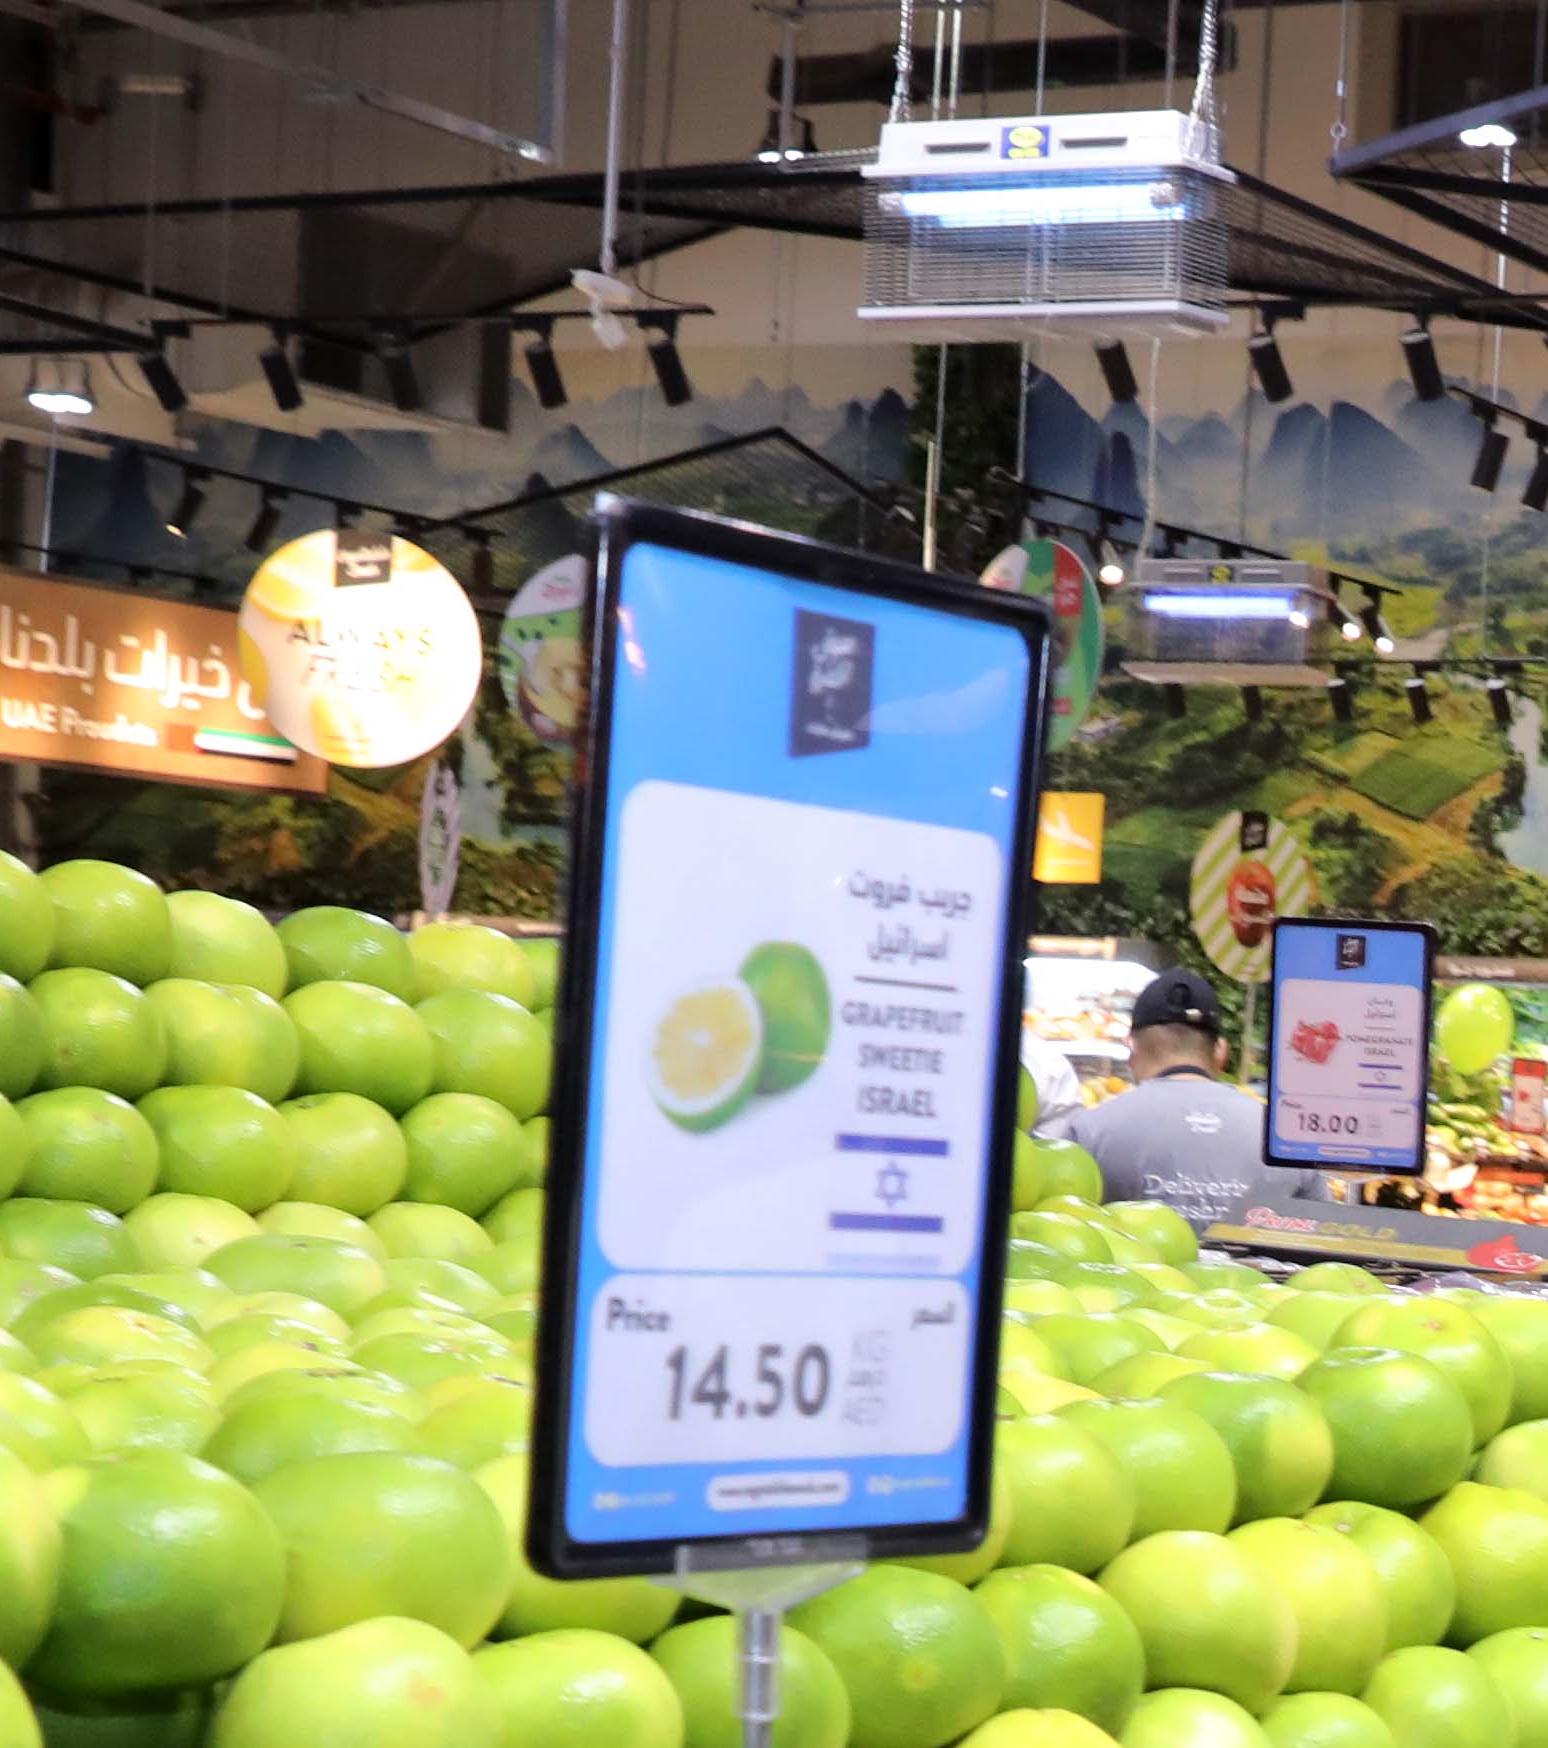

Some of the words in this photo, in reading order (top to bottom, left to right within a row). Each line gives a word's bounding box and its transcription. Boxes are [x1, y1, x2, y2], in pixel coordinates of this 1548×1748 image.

[104, 628, 231, 711] خيرات
[0, 696, 59, 735] UAE
[841, 1001, 965, 1035] GRAPEFRUIT
[858, 1043, 943, 1074] SWEETIE
[856, 1086, 938, 1118] ISRAEL
[1297, 1112, 1359, 1134] 18.00
[605, 1297, 671, 1332] Price
[666, 1344, 831, 1421] 14.50
